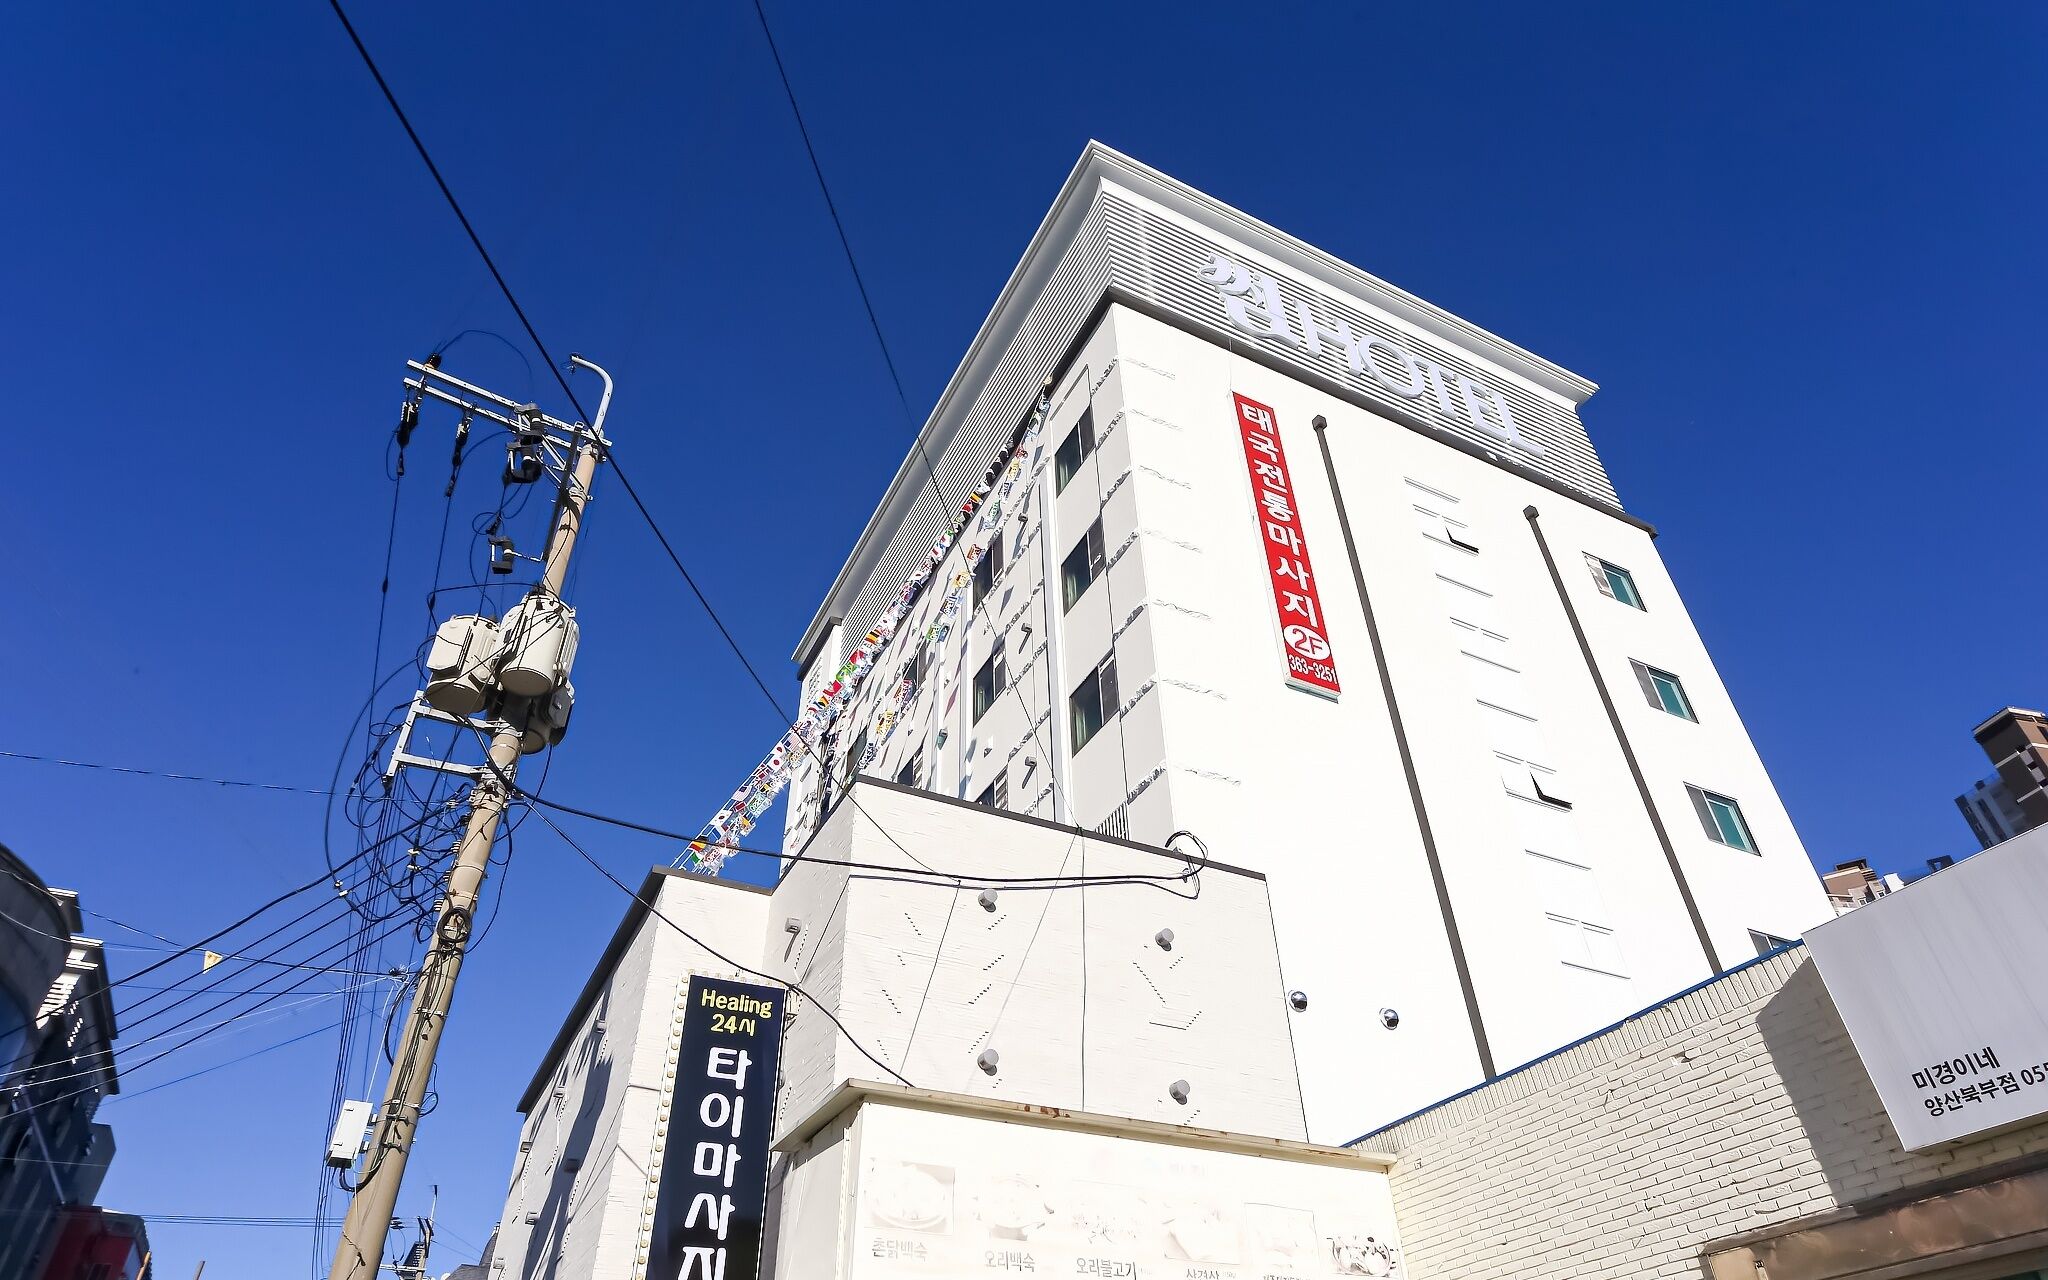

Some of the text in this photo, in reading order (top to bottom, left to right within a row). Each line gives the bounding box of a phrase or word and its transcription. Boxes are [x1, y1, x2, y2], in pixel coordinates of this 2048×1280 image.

[1294, 299, 1545, 458] HOTEL
[1292, 628, 1323, 655] 2F
[701, 988, 773, 1019] Healing
[710, 1014, 756, 1036] 24시
[1912, 1046, 2000, 1089] 미경이네
[1924, 1072, 2020, 1117] 양산북부점
[984, 1250, 1035, 1273] 오리백숙
[1076, 1257, 1137, 1280] 오리불고기
